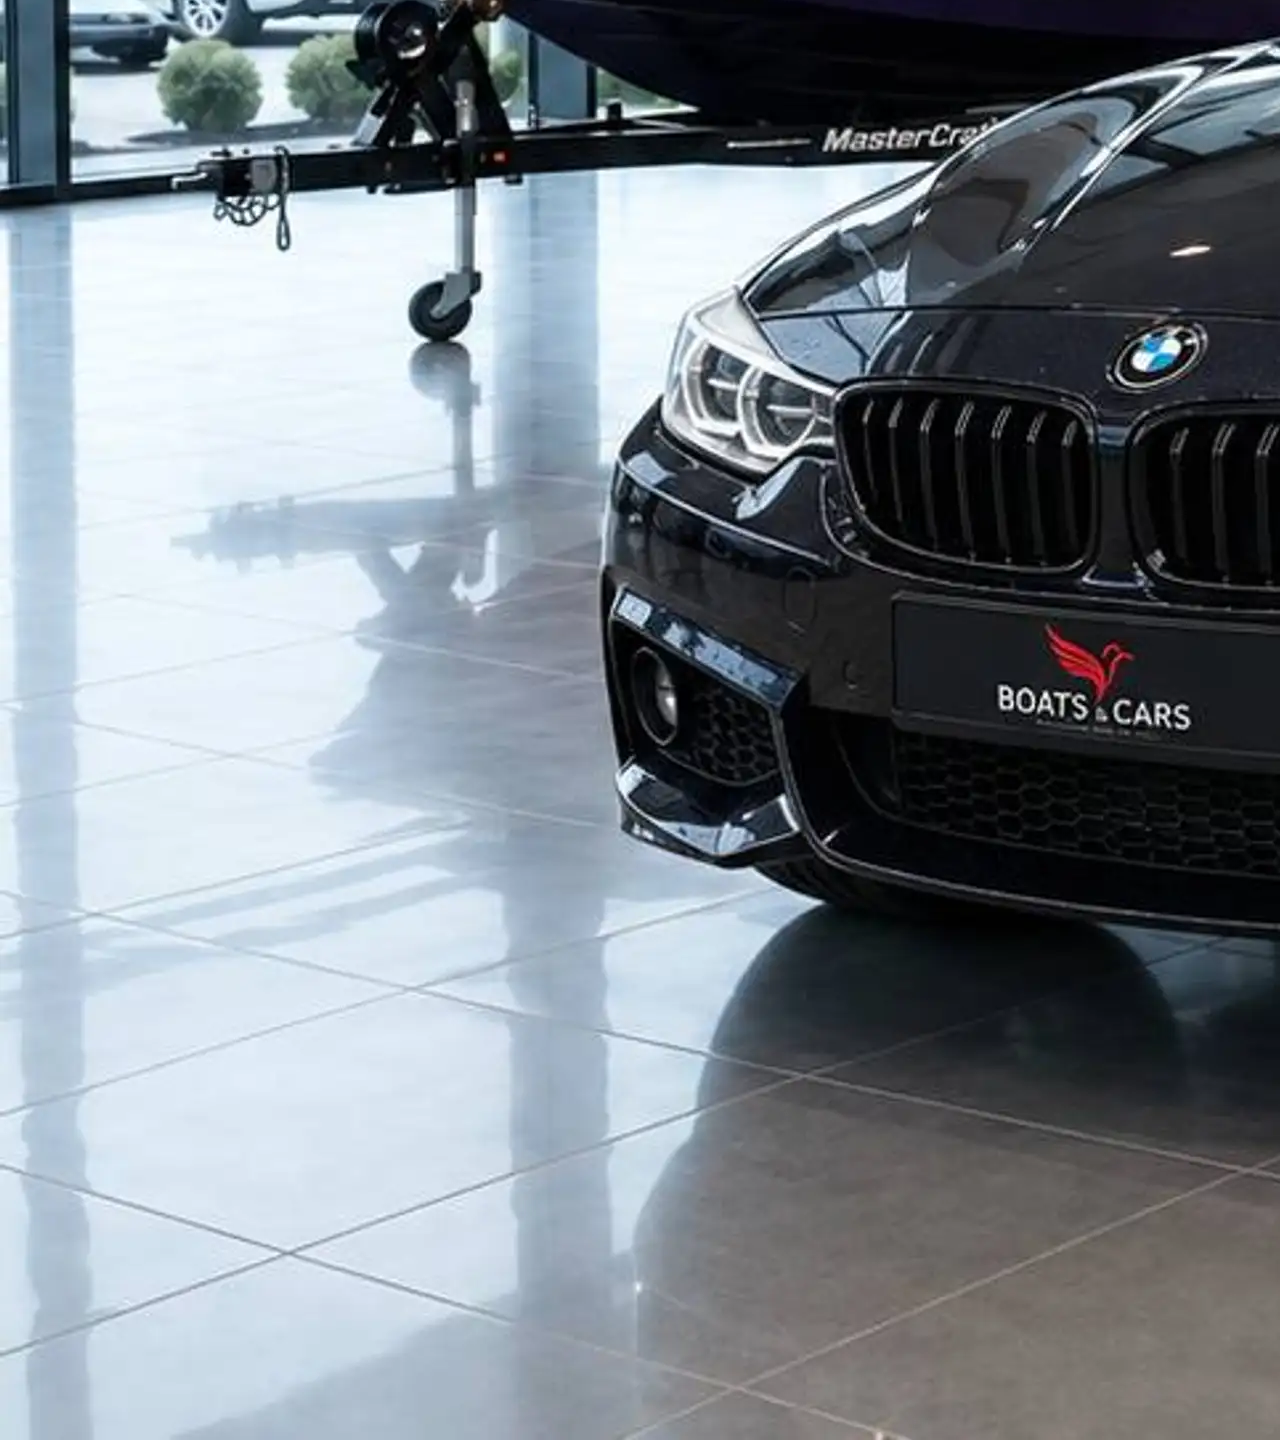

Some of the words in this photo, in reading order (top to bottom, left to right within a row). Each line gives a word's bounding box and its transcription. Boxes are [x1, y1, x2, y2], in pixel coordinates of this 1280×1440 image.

[822, 116, 998, 153] MasterCra
[997, 683, 1090, 722] BOATS
[1111, 698, 1192, 731] CARS
